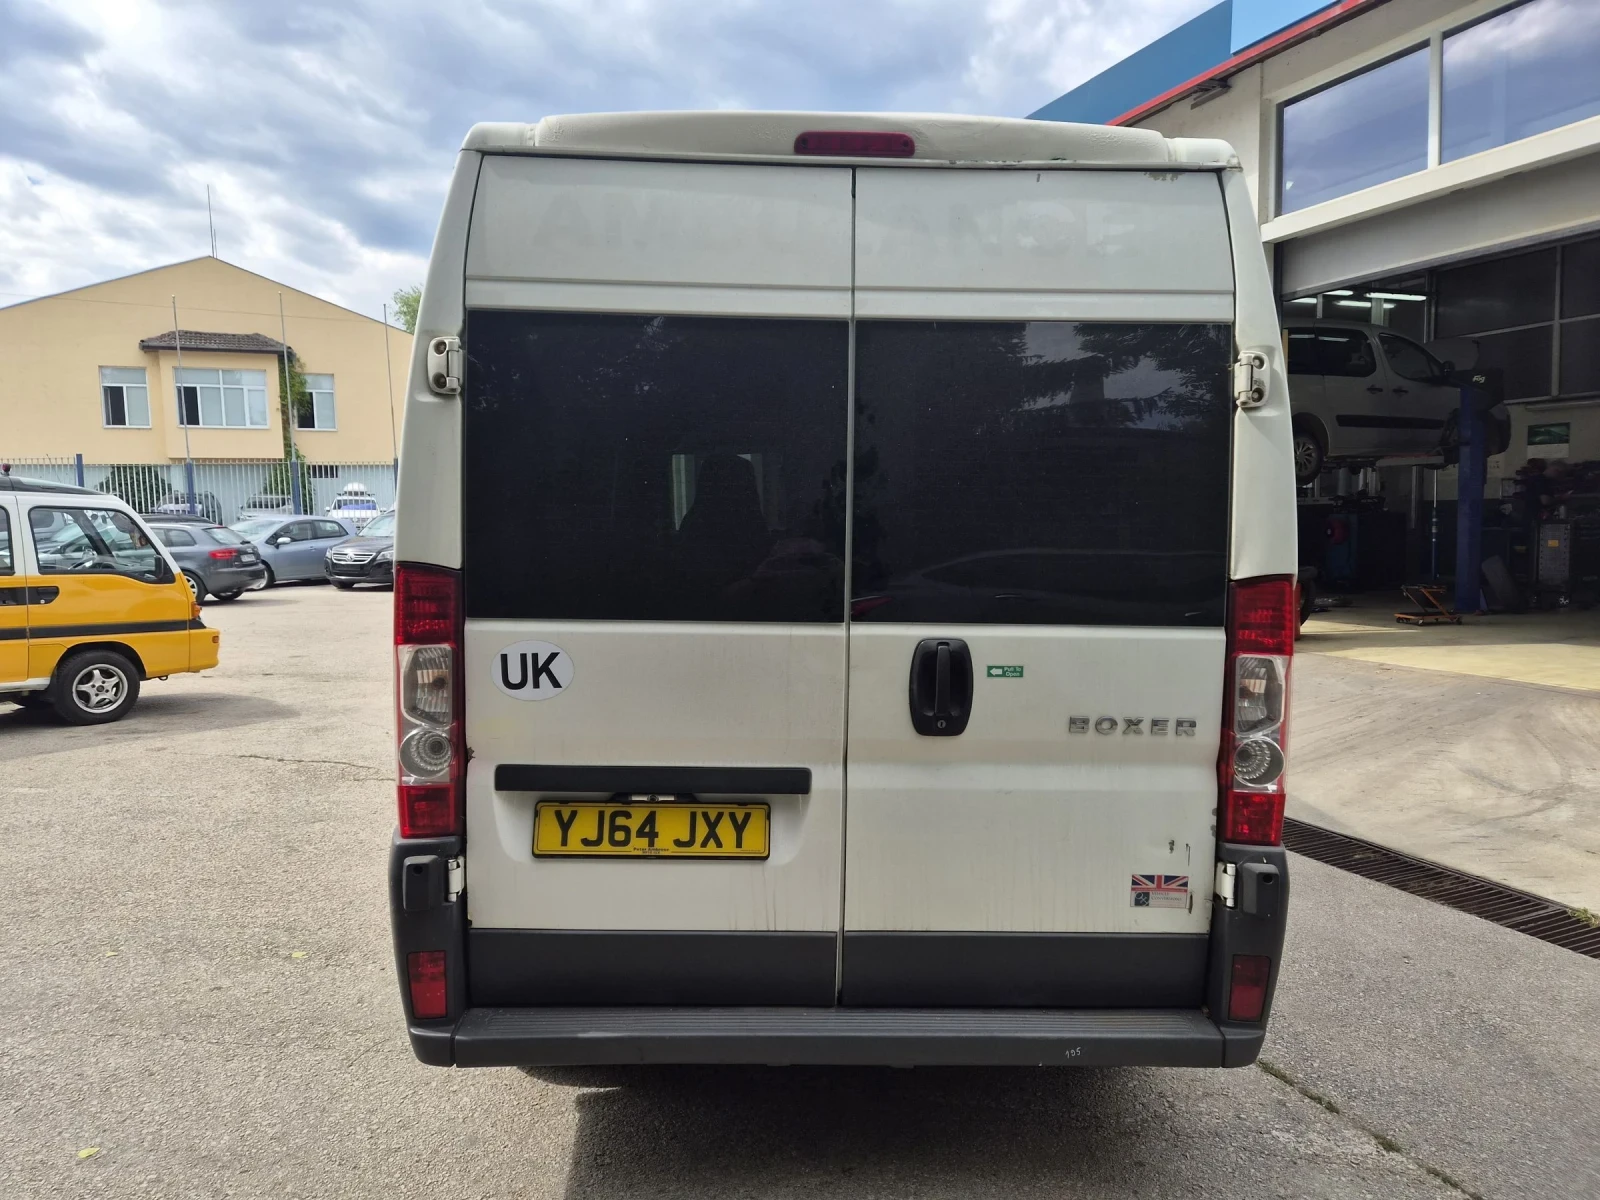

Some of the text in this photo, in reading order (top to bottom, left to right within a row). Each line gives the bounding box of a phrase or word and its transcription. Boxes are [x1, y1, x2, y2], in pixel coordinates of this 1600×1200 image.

[500, 651, 563, 690] UK
[1068, 715, 1197, 737] BOXER
[554, 809, 752, 849] YJ64 JXY
